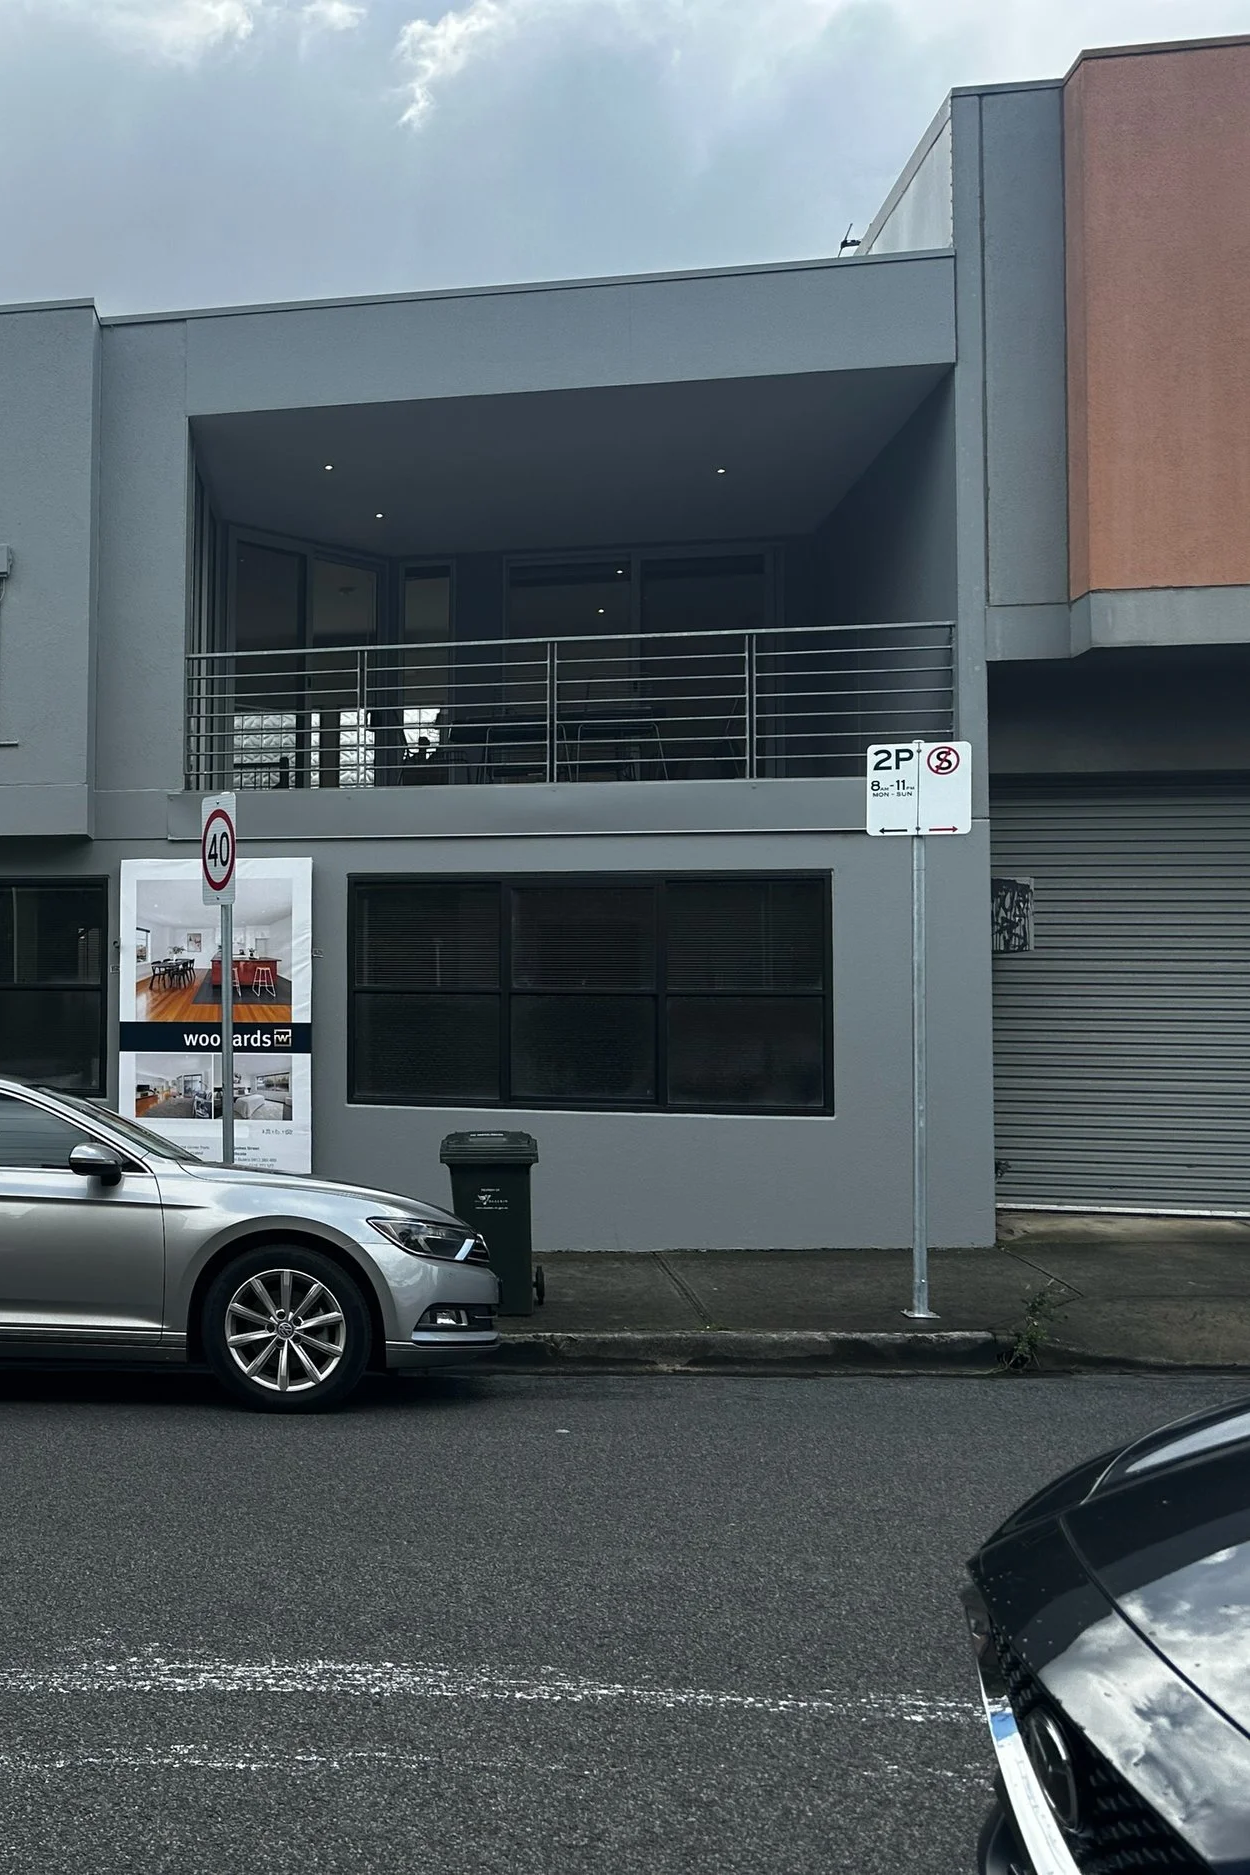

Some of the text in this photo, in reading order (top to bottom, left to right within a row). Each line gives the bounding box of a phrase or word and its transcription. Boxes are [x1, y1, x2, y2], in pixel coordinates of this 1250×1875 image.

[873, 749, 914, 771] 2P
[208, 831, 230, 868] 40
[183, 1029, 272, 1047] wooards
